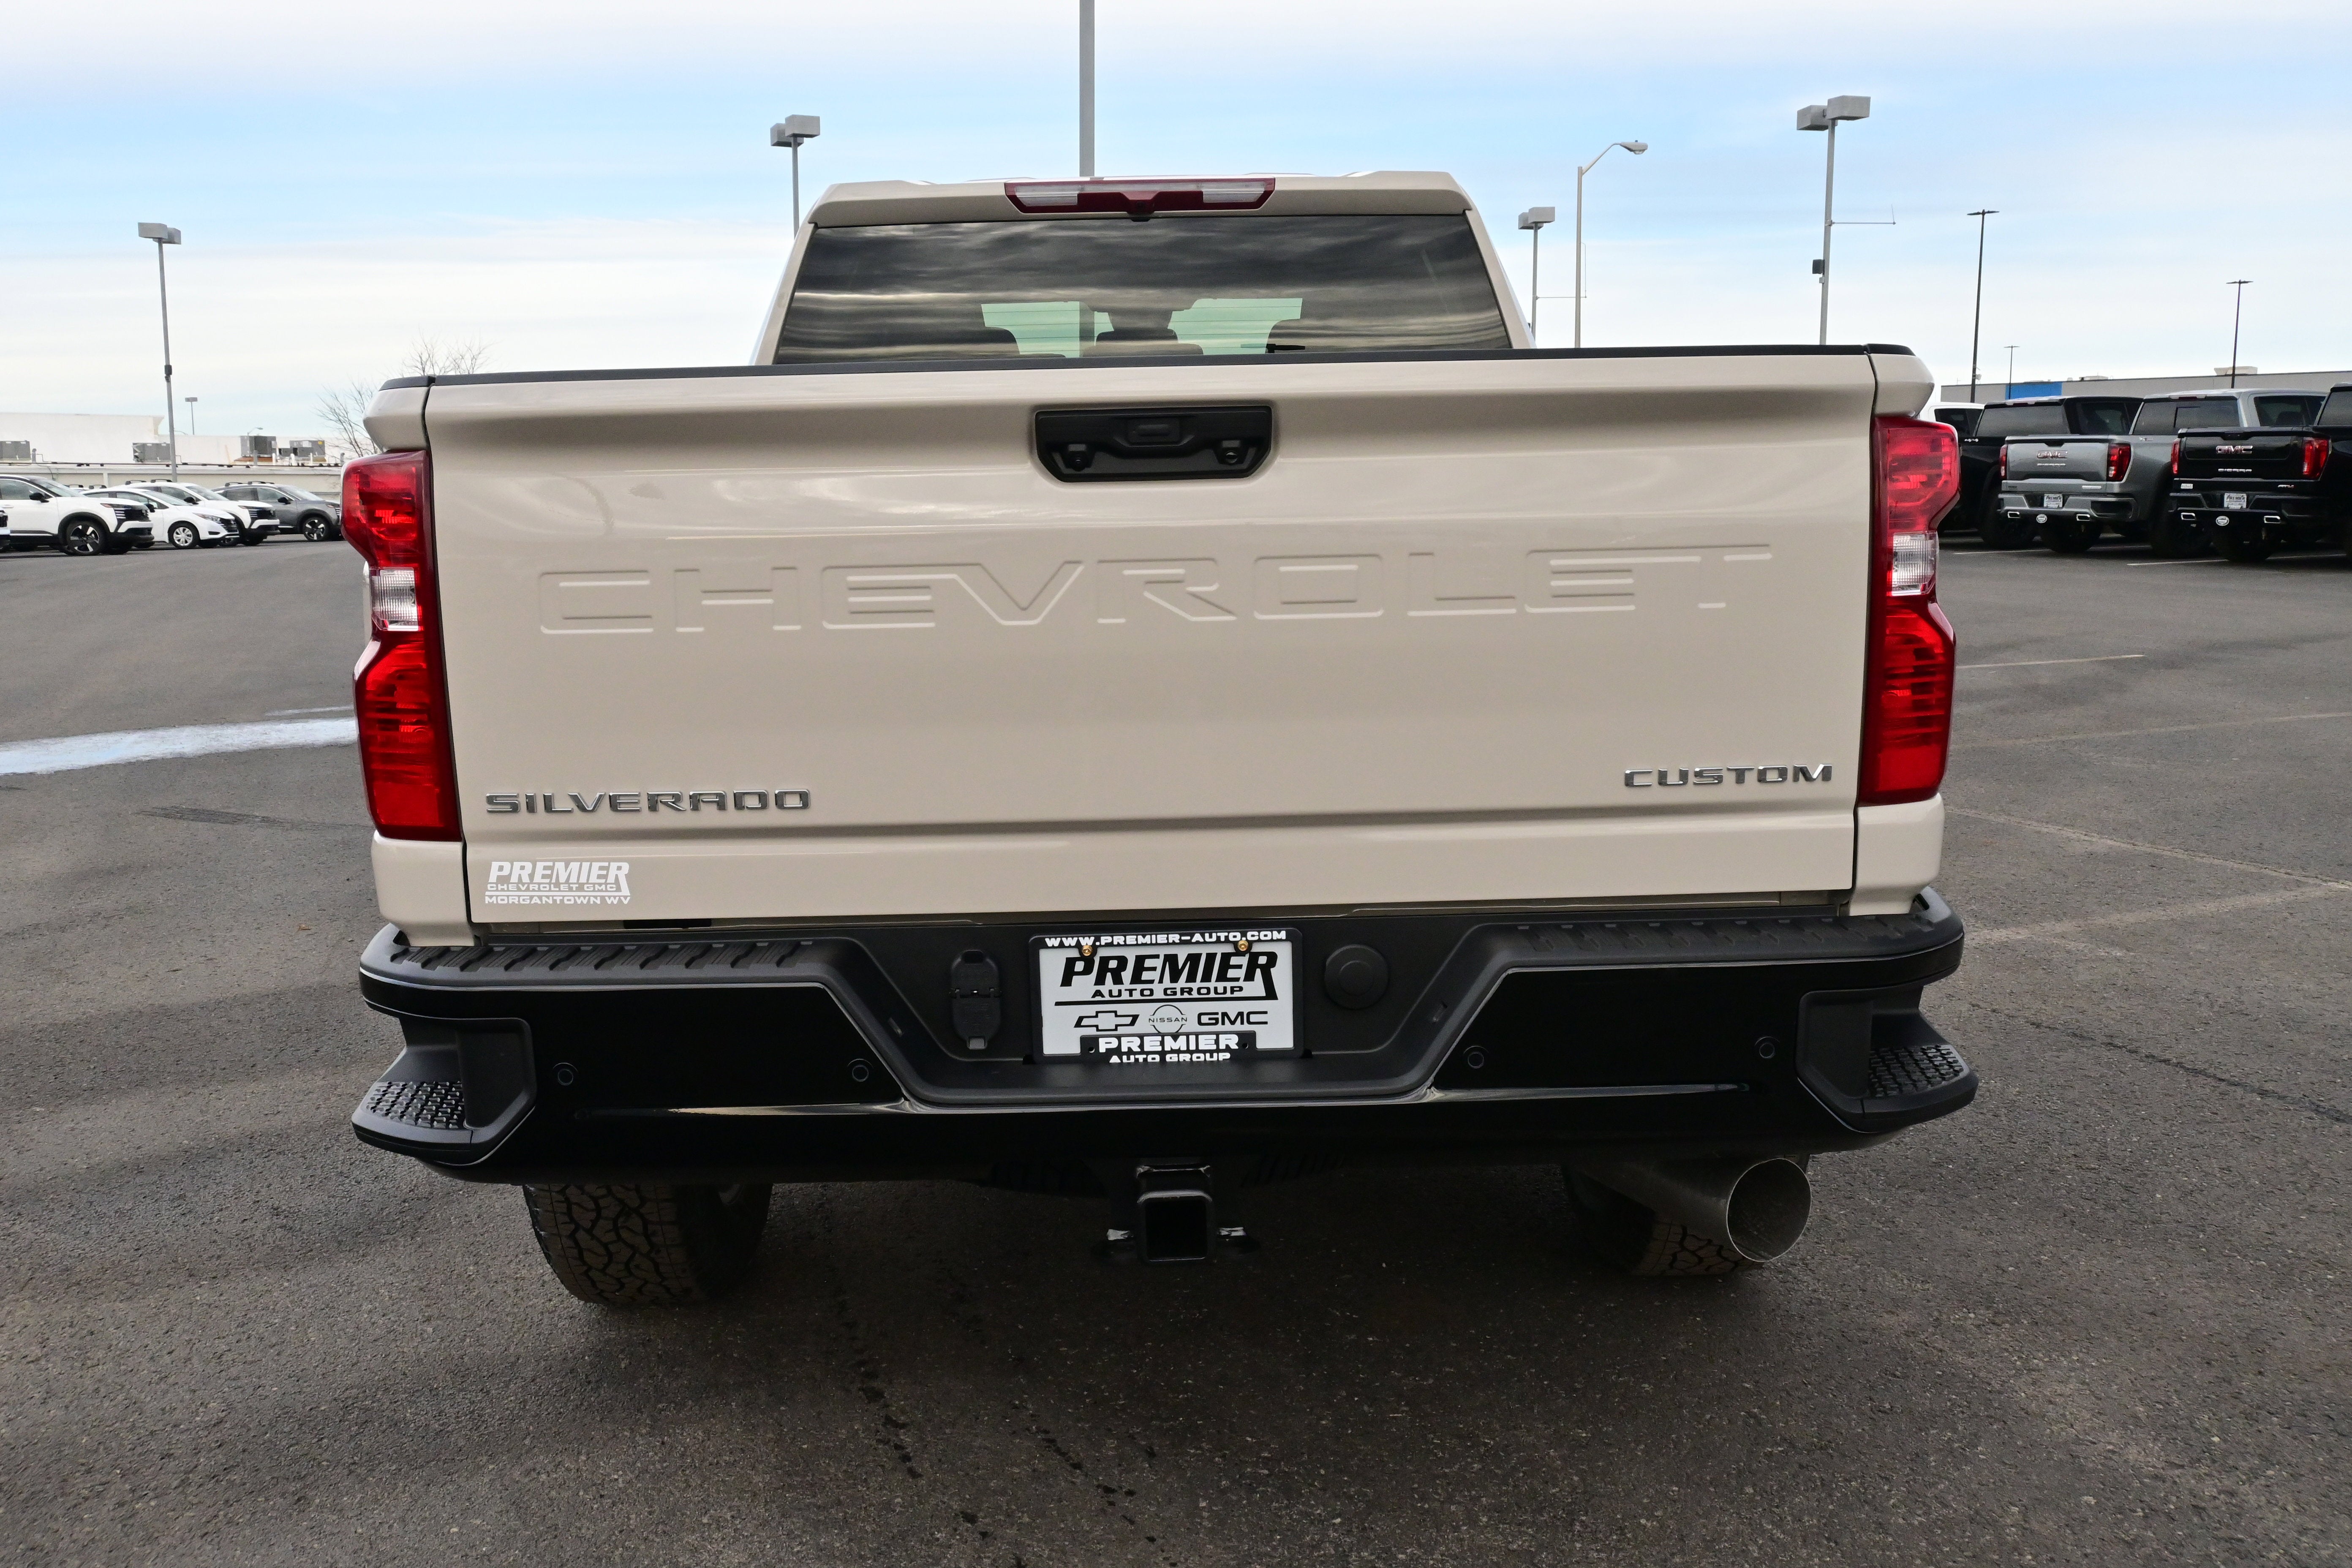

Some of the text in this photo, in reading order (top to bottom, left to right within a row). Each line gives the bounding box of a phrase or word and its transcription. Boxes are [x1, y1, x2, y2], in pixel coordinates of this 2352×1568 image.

[2037, 450, 2068, 459] GMC
[2216, 446, 2253, 454] GMC
[539, 543, 1772, 634] CHEVROLET
[1625, 764, 1832, 787] CUSTOM
[486, 788, 811, 813] SILVERADO
[488, 861, 630, 891] PREMIER
[485, 896, 601, 904] MORGANTOWN
[1045, 931, 1286, 947] WWW.PREMIER-AUTO.COM
[1060, 951, 1279, 997] PREMIER
[1091, 985, 1244, 998] AUTO GROUP
[1197, 1011, 1268, 1026] GMC
[1098, 1034, 1239, 1053] PREMIER
[1108, 1052, 1231, 1063] AUTO GROUP
